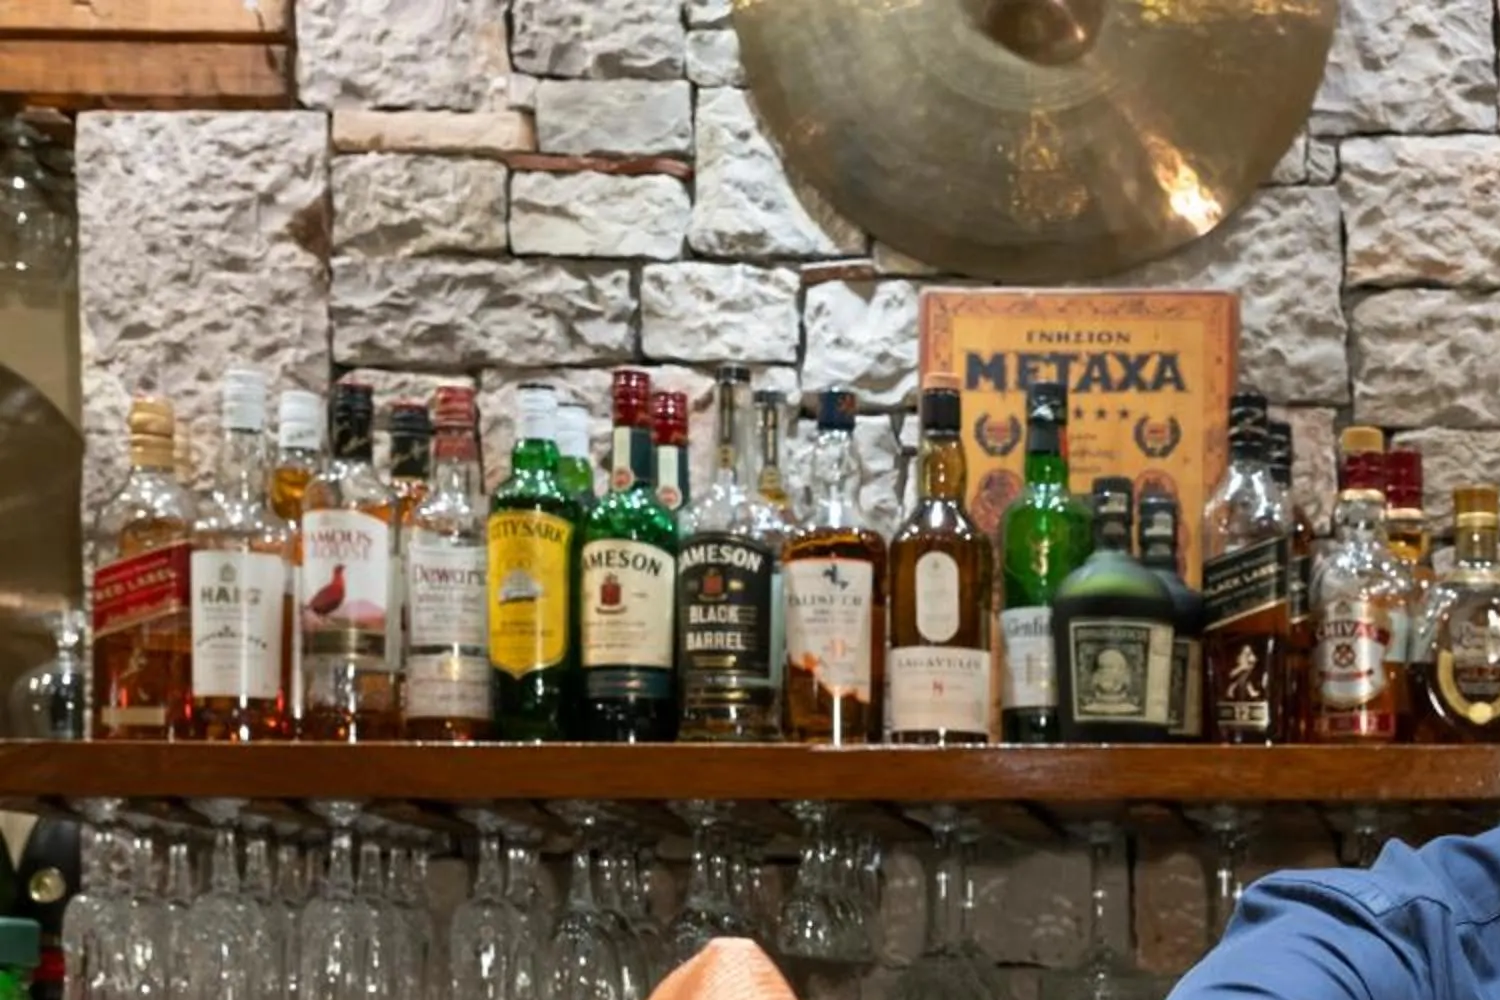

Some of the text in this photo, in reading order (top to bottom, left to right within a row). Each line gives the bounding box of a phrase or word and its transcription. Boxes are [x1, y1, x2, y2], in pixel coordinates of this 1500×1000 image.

[1025, 329, 1132, 345] ΓΝΗΣΙΟΝ
[965, 352, 1186, 392] METAXA
[583, 549, 664, 577] AMESON
[689, 604, 740, 625] BLACK
[686, 631, 747, 651] BARREL
